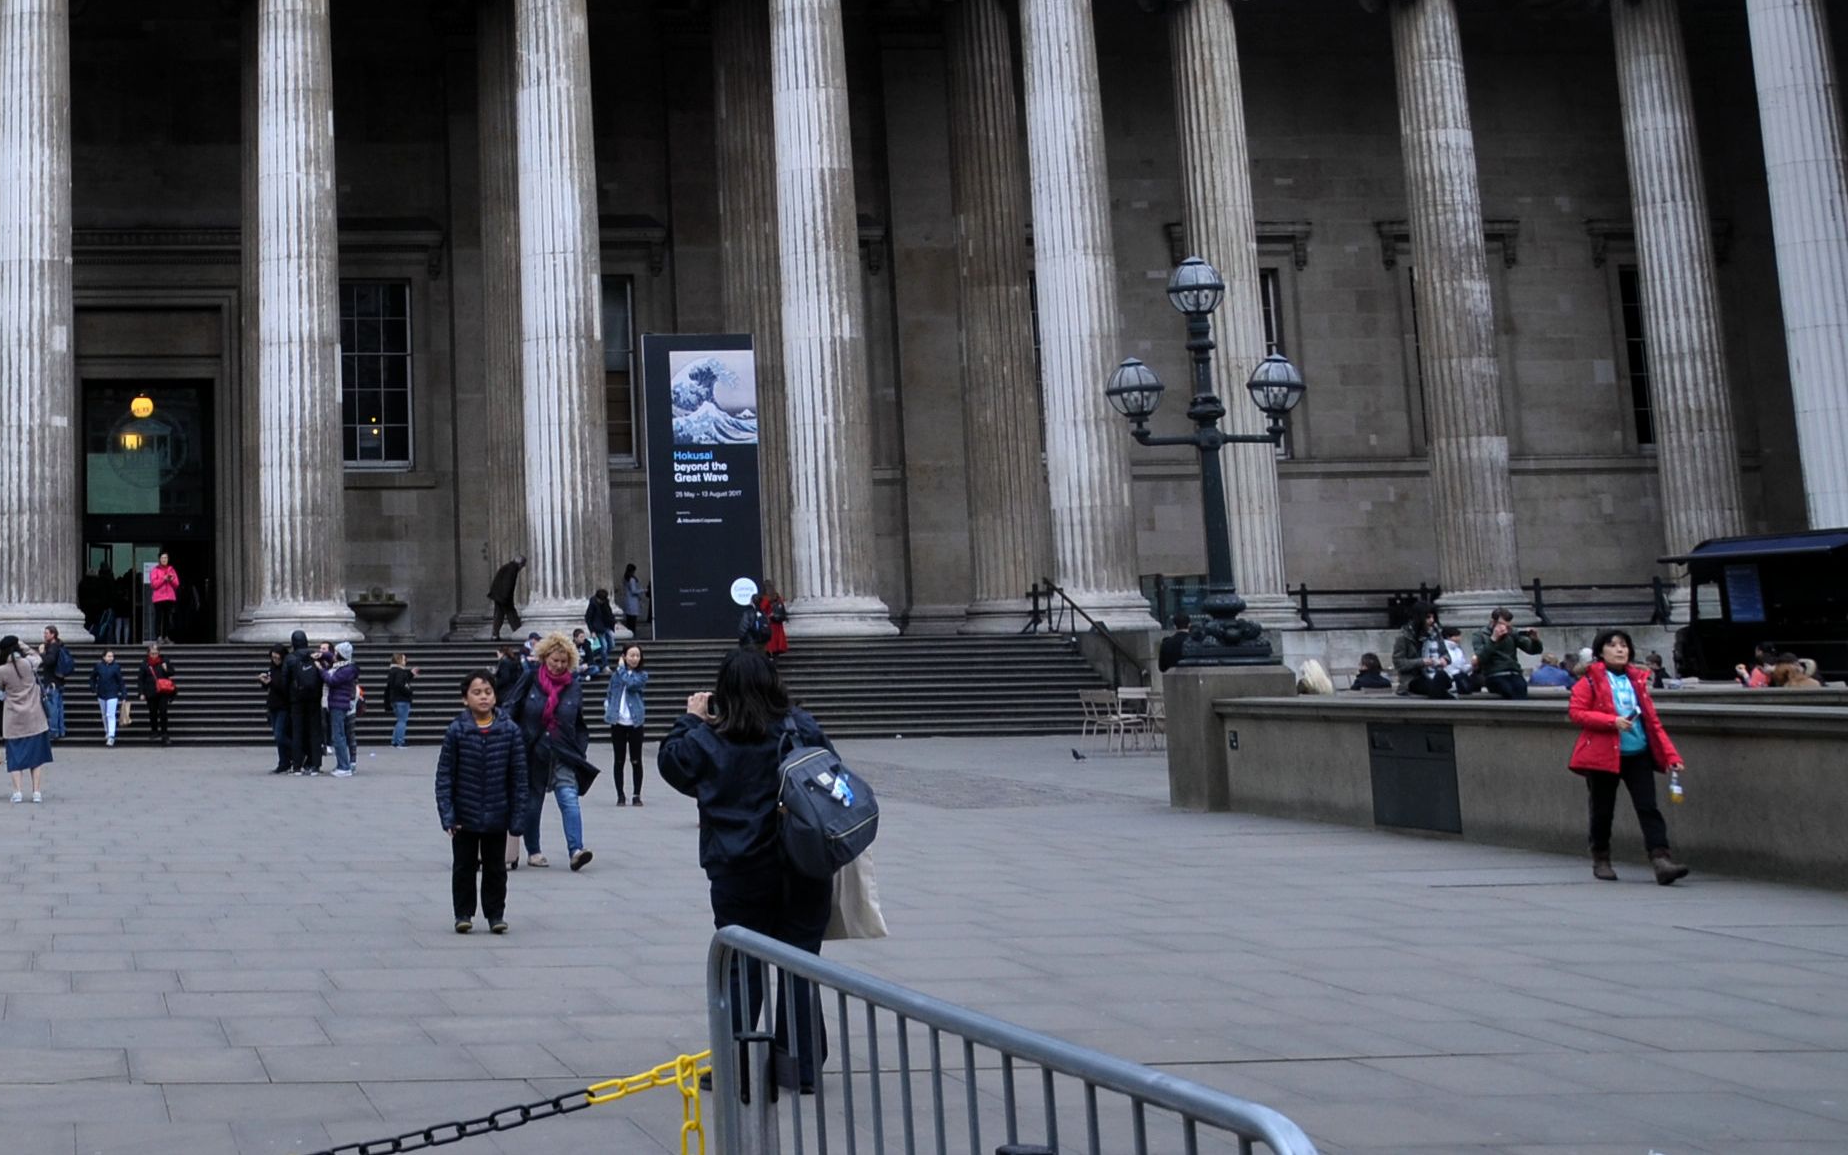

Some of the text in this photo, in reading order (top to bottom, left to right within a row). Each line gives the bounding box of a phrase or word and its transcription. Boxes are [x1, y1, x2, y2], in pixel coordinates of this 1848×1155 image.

[674, 451, 713, 460] Hokusai
[674, 462, 728, 473] beyond the
[674, 473, 729, 482] Great Wave
[709, 490, 728, 498] August
